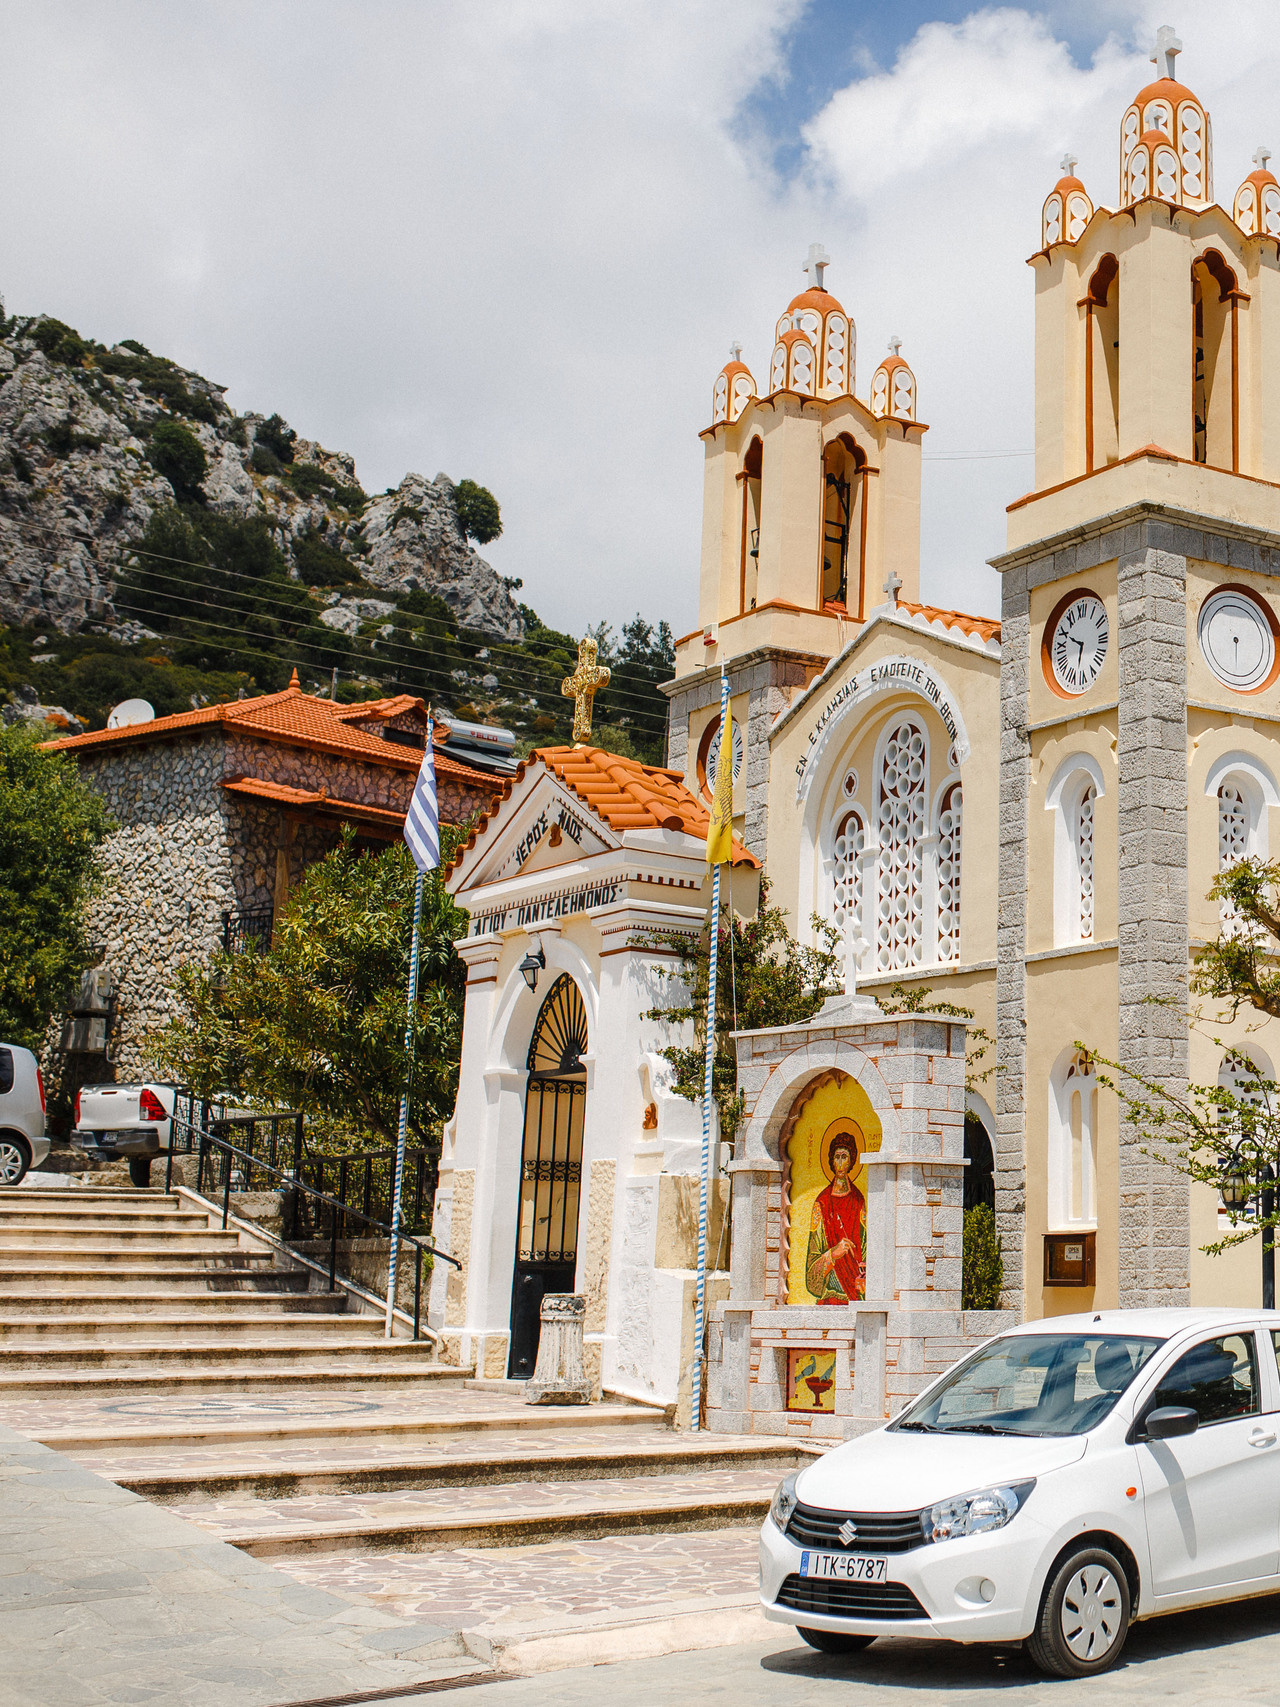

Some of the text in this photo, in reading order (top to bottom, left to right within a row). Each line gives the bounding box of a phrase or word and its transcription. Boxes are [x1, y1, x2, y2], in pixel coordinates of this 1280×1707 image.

[1058, 626, 1069, 639] X
[795, 755, 808, 777] ΕΝ
[924, 676, 942, 704] ΤΟΝ
[940, 702, 959, 743] ΘΕΟΝ
[517, 884, 619, 926] ΠΑΝΤΕΛΕΗΜΟΝΟΣ
